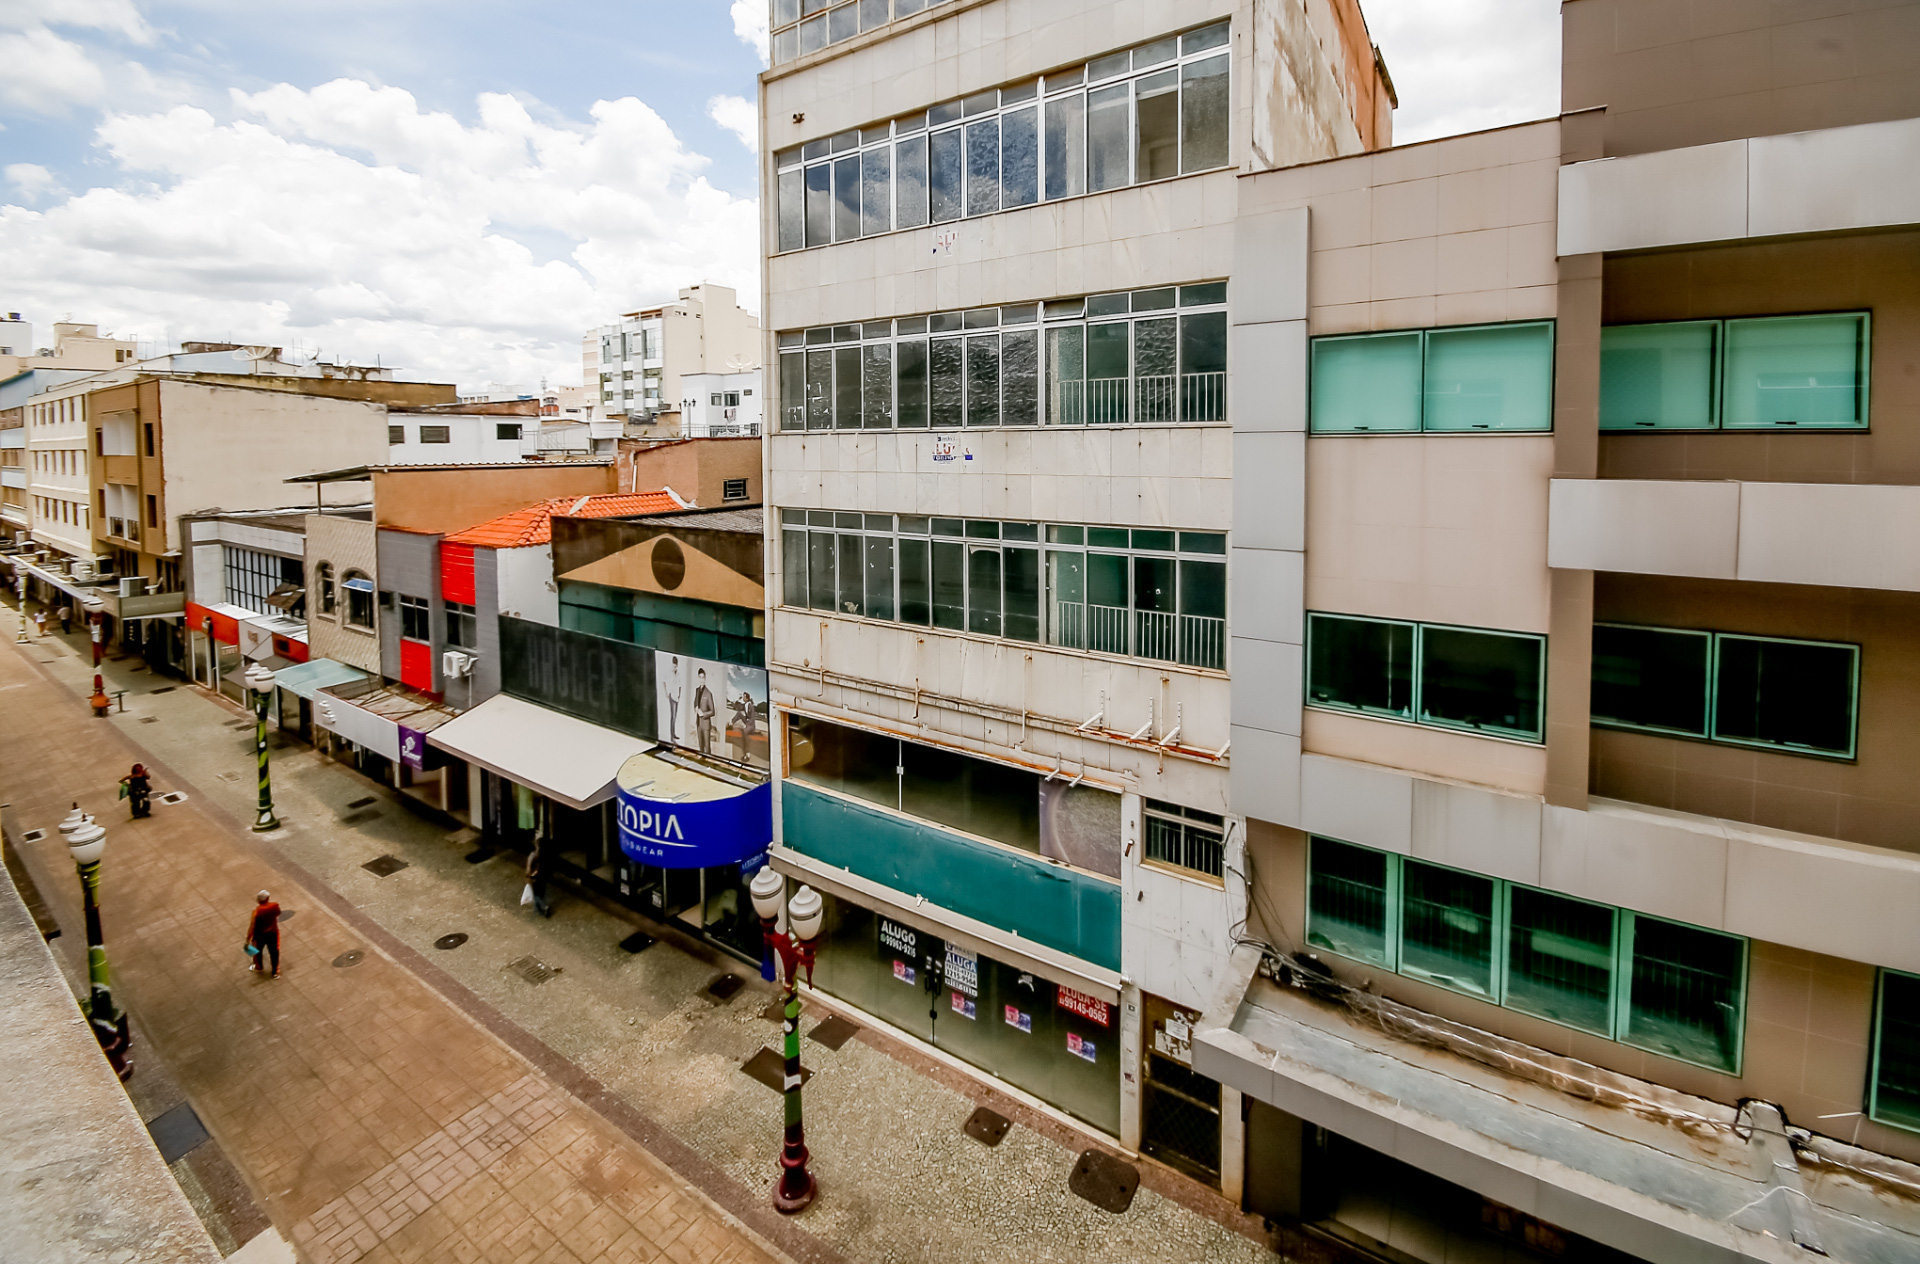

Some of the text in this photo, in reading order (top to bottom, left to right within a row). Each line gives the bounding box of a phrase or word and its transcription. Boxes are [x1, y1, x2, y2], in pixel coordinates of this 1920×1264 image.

[617, 797, 684, 840] TOPIA
[881, 920, 916, 946] ALUGO
[945, 952, 977, 973] ALUGA
[1065, 996, 1107, 1024] 99145-0562
